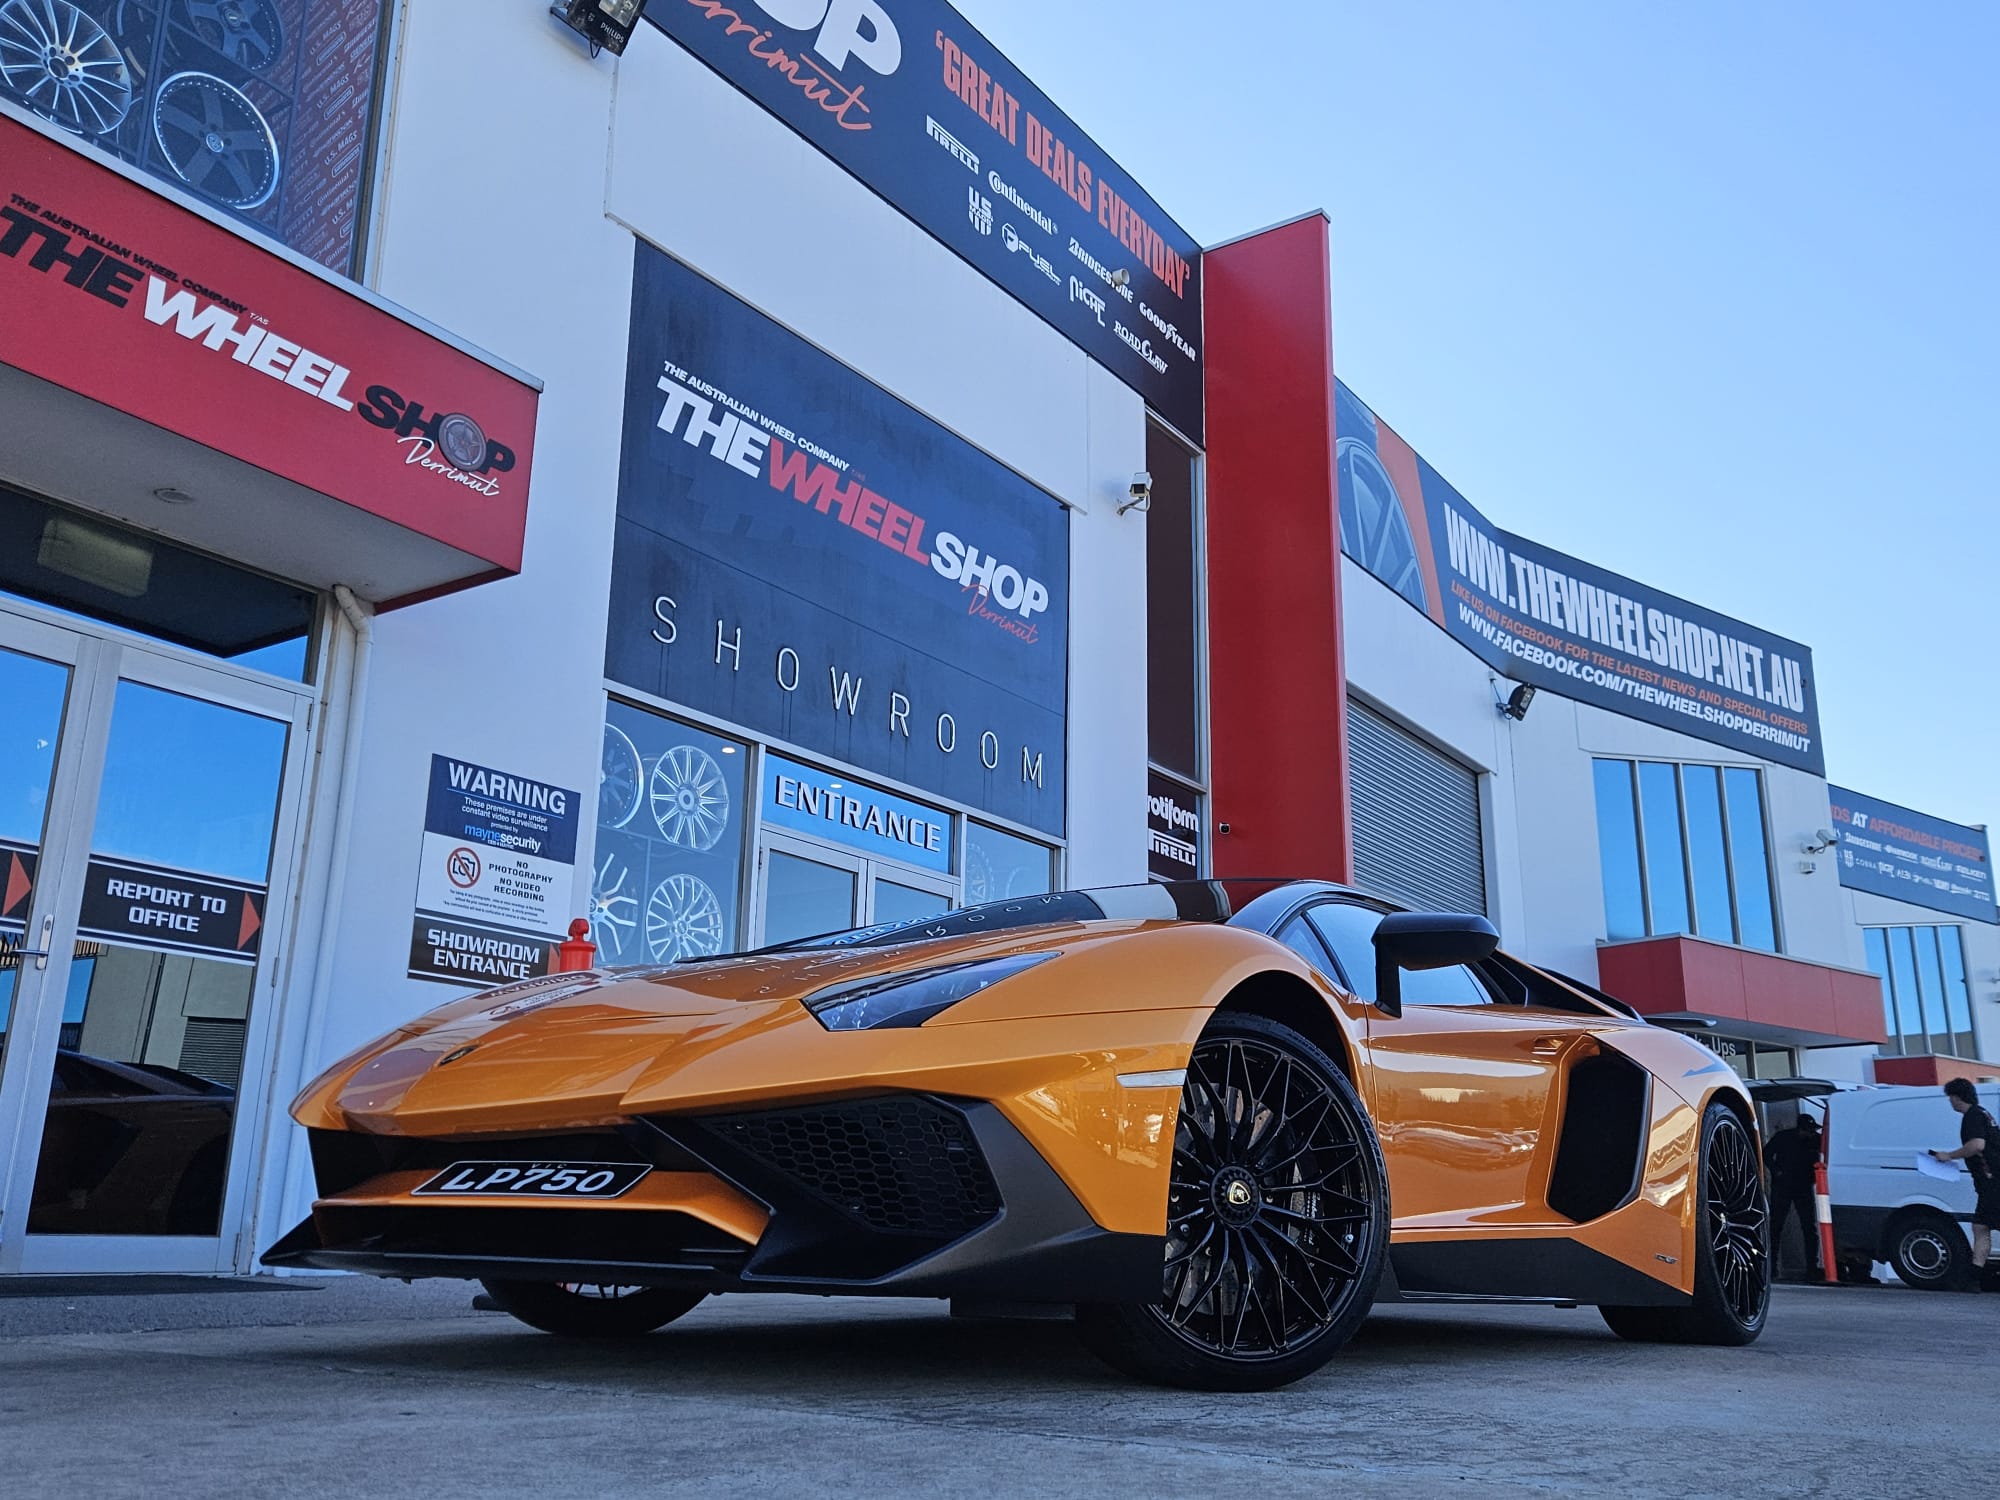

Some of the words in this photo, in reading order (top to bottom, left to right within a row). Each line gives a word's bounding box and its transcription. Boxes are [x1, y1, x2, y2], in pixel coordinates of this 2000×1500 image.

[600, 22, 624, 43] PHILIPS
[330, 73, 349, 94] MAGS
[324, 150, 338, 166] U.S.
[338, 131, 358, 152] MAGS
[926, 115, 979, 175] PIRELLI
[1026, 111, 1091, 213] DEALS
[11, 193, 41, 214] THE
[40, 210, 132, 258] AUSTRALIAN
[133, 253, 179, 283] WHEEL
[182, 279, 248, 314] COMPANY
[1018, 240, 1062, 284] FUEL
[250, 312, 269, 325] T/AS
[1139, 302, 1196, 361] GOODYEAR
[0, 206, 145, 308] THE
[144, 275, 354, 411] WHEEL
[357, 385, 515, 474] SHOP
[664, 360, 688, 382] THE
[687, 375, 758, 421] AUSTRALIAN
[760, 415, 796, 444] WHEEL
[798, 437, 849, 472] COMPANY
[397, 436, 499, 496] Derrimut
[656, 375, 771, 479] THE
[769, 436, 930, 566] WHEEL
[930, 531, 1049, 618] SHOP
[961, 584, 1038, 645] Derrimut
[1443, 502, 1804, 713] WWW.THEWHEELSHOP.NET.AU
[1451, 579, 1470, 603] LIKE
[1471, 596, 1484, 614] US
[1485, 605, 1499, 623] ON
[1501, 615, 1563, 651] FACEBOOK
[1565, 642, 1589, 661] FOR
[1591, 651, 1614, 670] THE
[1616, 660, 1661, 684] LATEST
[1662, 676, 1696, 697] NEWS
[1698, 689, 1722, 706] AND
[1724, 697, 1767, 721] SPECIAL
[1770, 713, 1808, 735] OFFERS
[1459, 602, 1810, 752] WWW.FACEBOOK.COM/THEWHEELSHOPDERRIMUT
[651, 596, 1043, 789] SHOWROOM
[449, 762, 566, 816] WARNING
[462, 805, 491, 817] constant
[491, 812, 509, 822] video
[511, 817, 548, 832] surveillance
[464, 796, 485, 808] These
[486, 803, 515, 817] premises
[517, 810, 527, 819] are
[528, 813, 547, 824] under
[776, 775, 942, 853] ENTRANCE
[1148, 828, 1197, 867] PIRELLI
[1852, 811, 1868, 828] AT
[1869, 817, 1941, 851] AFFORDABLE
[489, 863, 552, 883] PHOTOGRAPHY
[499, 877, 512, 886] NO
[515, 881, 541, 892] VIDEO
[517, 861, 528, 869] NO
[106, 878, 194, 909] REPORT
[200, 895, 226, 914] TO
[494, 885, 544, 902] RECORDING
[128, 906, 201, 933] OFFICE
[427, 928, 540, 964] SHOWROOM
[433, 948, 531, 980] ENTRANCE
[440, 1168, 615, 1192] LP750
